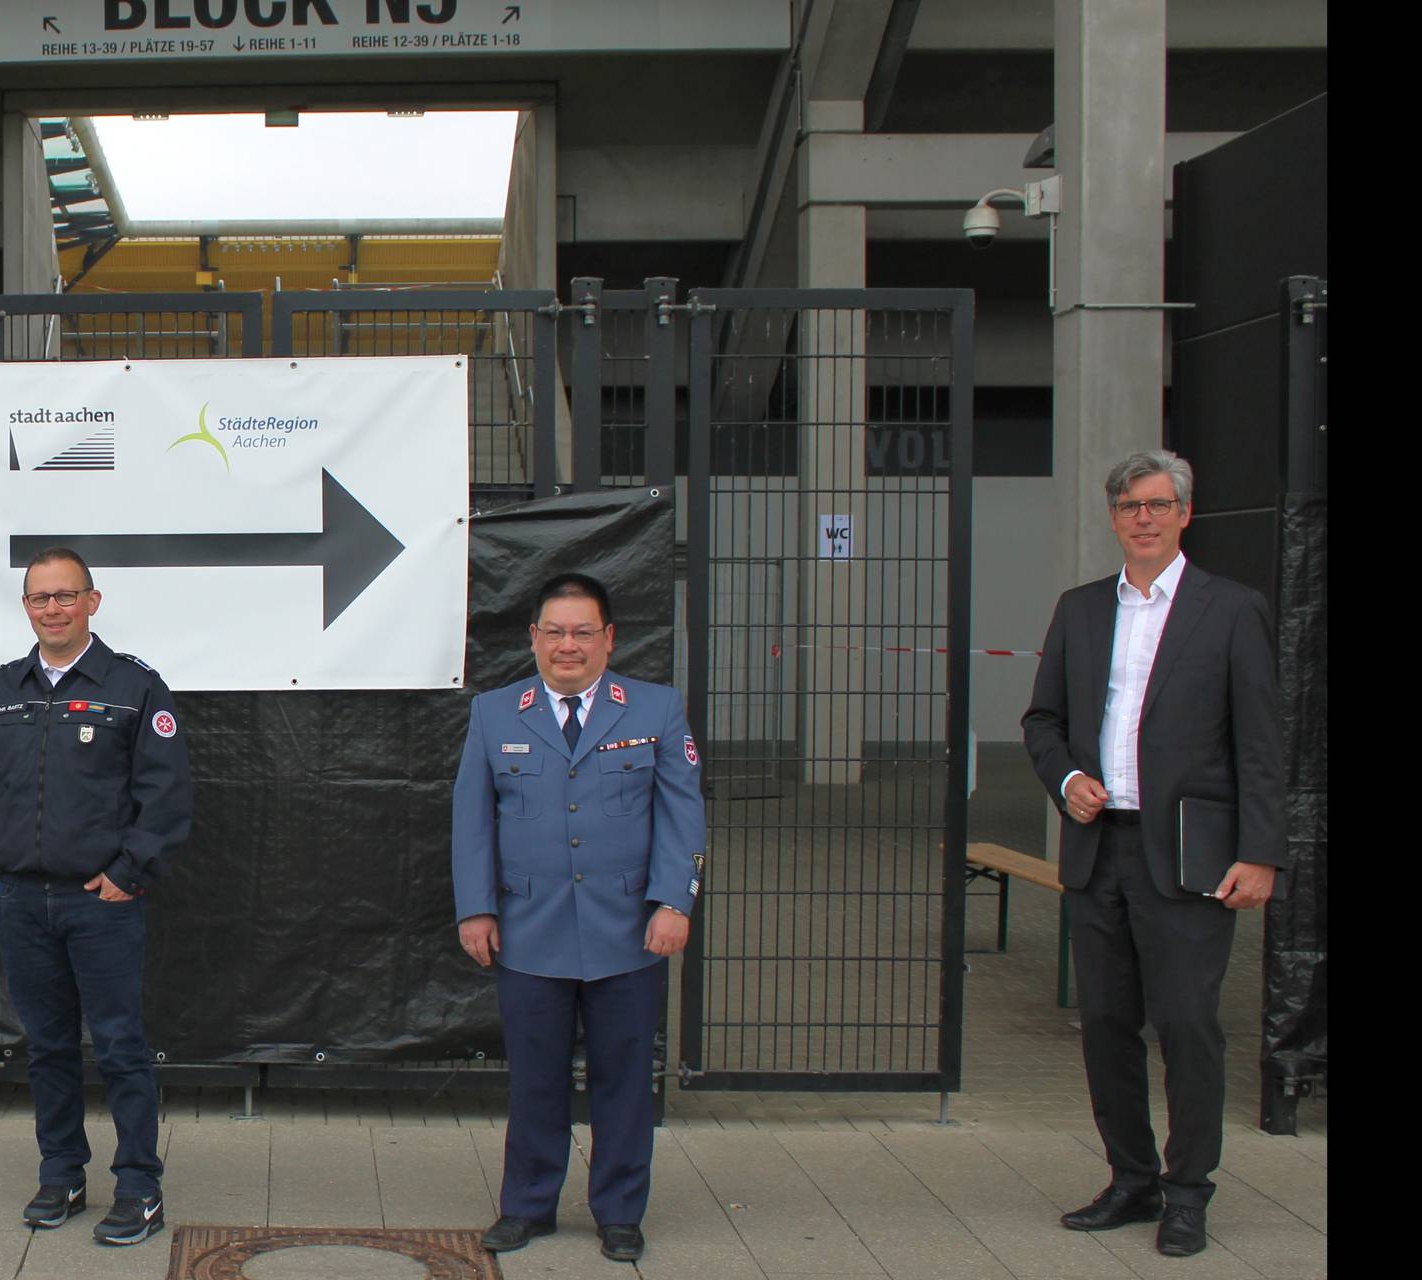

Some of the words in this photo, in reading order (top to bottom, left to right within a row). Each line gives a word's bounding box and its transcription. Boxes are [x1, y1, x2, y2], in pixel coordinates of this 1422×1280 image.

[42, 43, 78, 56] REIHE
[81, 41, 118, 54] 13-39
[130, 38, 175, 53] PLÄTZE
[179, 39, 215, 52] 19-57
[249, 38, 286, 50] REIHE
[289, 37, 316, 49] 1-11
[352, 36, 389, 48] REIHE
[393, 35, 429, 47] 12-39
[441, 32, 488, 46] PLÄTZE
[492, 34, 521, 46] 1-18
[9, 407, 52, 424] stadt
[54, 406, 115, 423] aachen
[217, 416, 319, 433] StädteRegion
[232, 434, 287, 448] Aachen
[825, 527, 849, 540] WC
